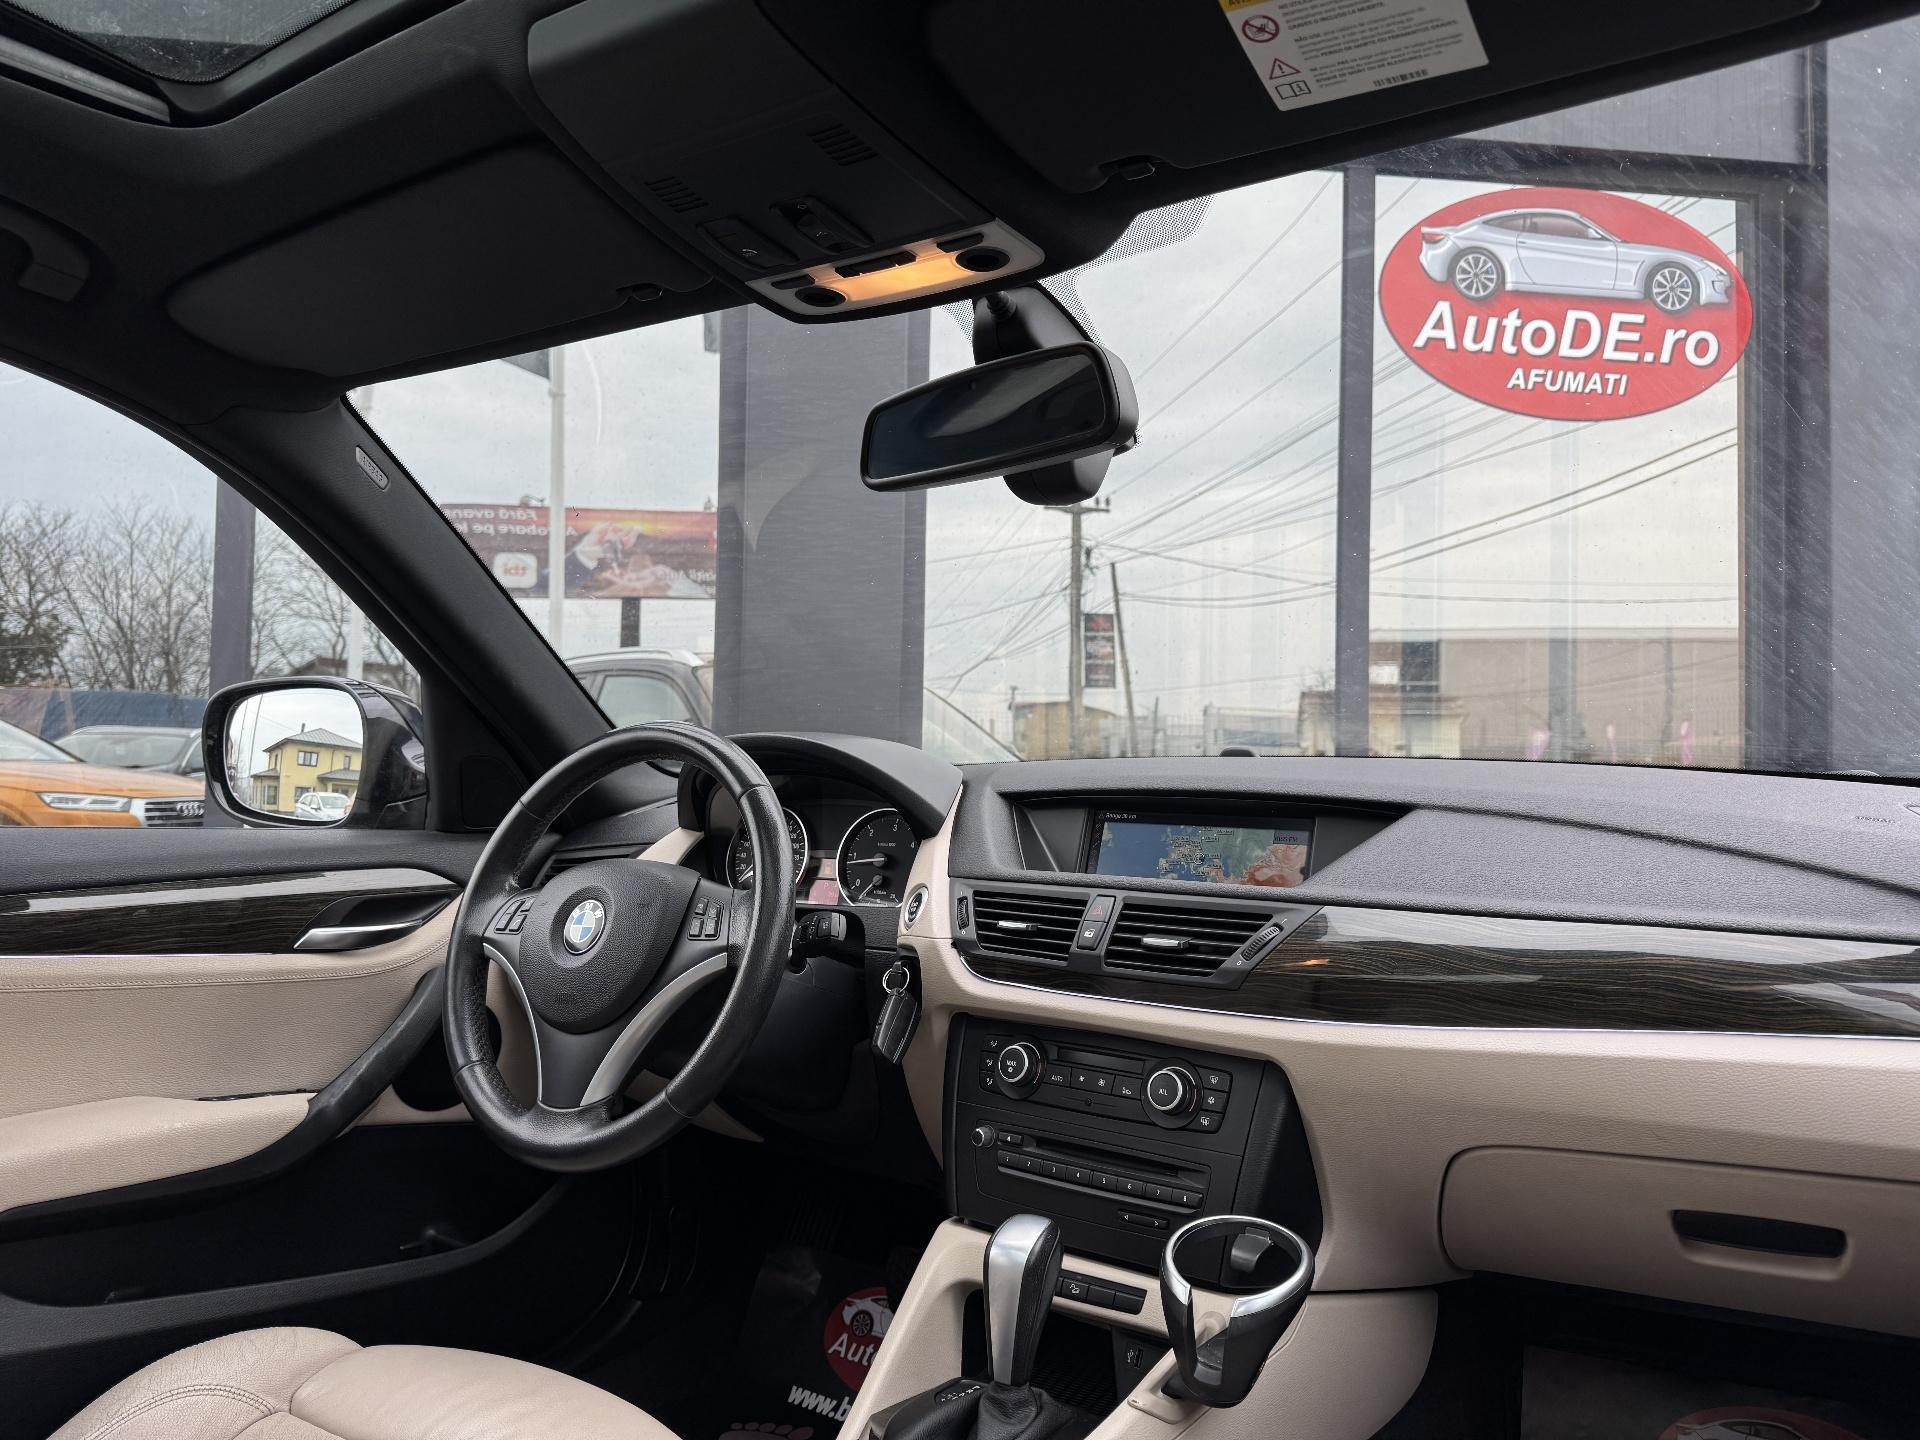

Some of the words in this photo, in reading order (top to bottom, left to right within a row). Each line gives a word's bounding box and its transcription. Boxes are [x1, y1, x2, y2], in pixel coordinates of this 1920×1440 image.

[1413, 301, 1719, 368] AutoDE.ro
[1507, 367, 1629, 396] AFUMATI
[572, 902, 603, 919] BMW
